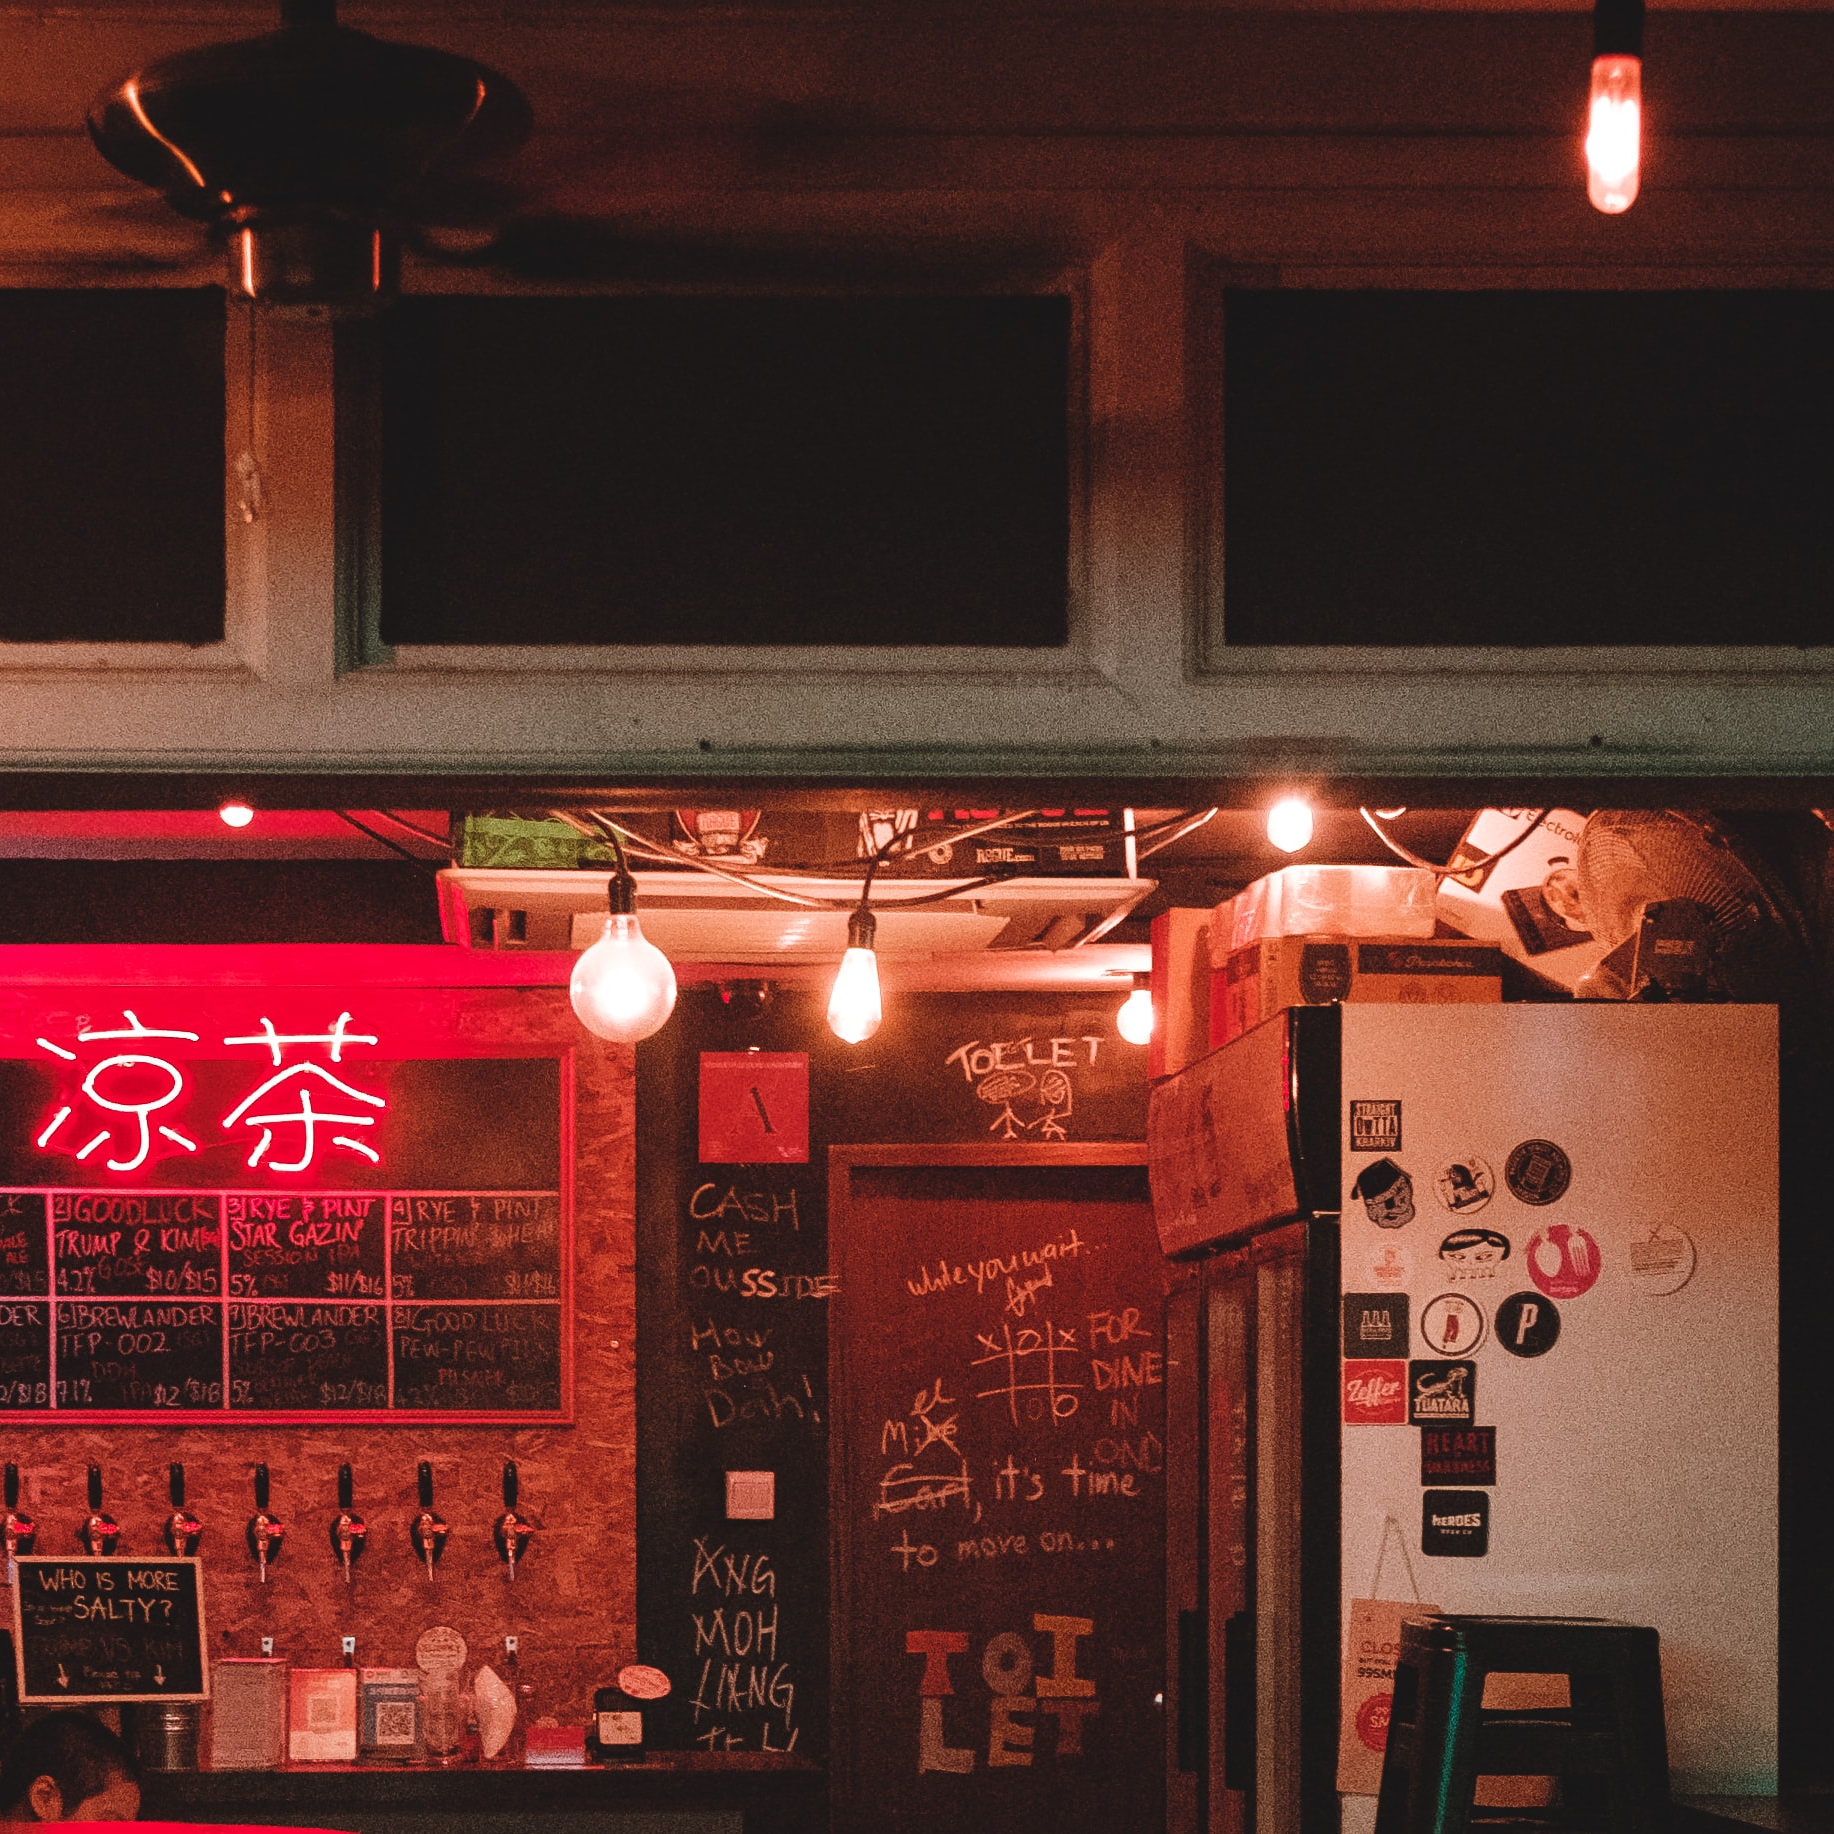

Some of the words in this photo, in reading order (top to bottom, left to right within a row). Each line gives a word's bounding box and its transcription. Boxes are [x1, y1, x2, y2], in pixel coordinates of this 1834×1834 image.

[36, 1009, 386, 1173] 凉茶
[689, 1182, 800, 1232] CASH
[55, 1228, 122, 1258] TRUMP
[230, 1220, 280, 1250] STAR
[696, 1230, 755, 1256] ME
[76, 1306, 218, 1330] BREWLANDER
[247, 1307, 381, 1330] BREWLANDER
[1087, 1307, 1152, 1350] FOR
[1347, 1377, 1402, 1408] Zeffer
[1414, 1398, 1469, 1412] TUATARA
[1426, 1432, 1490, 1454] HEART
[1062, 1453, 1139, 1498] time
[891, 1529, 941, 1574] to
[958, 1534, 1030, 1561] move
[39, 1568, 87, 1592] WHO
[95, 1572, 115, 1591] IS
[127, 1570, 180, 1591] MORE
[73, 1595, 173, 1626] SALTY?
[690, 1602, 780, 1664] MOH
[919, 1696, 1100, 1774] LET
